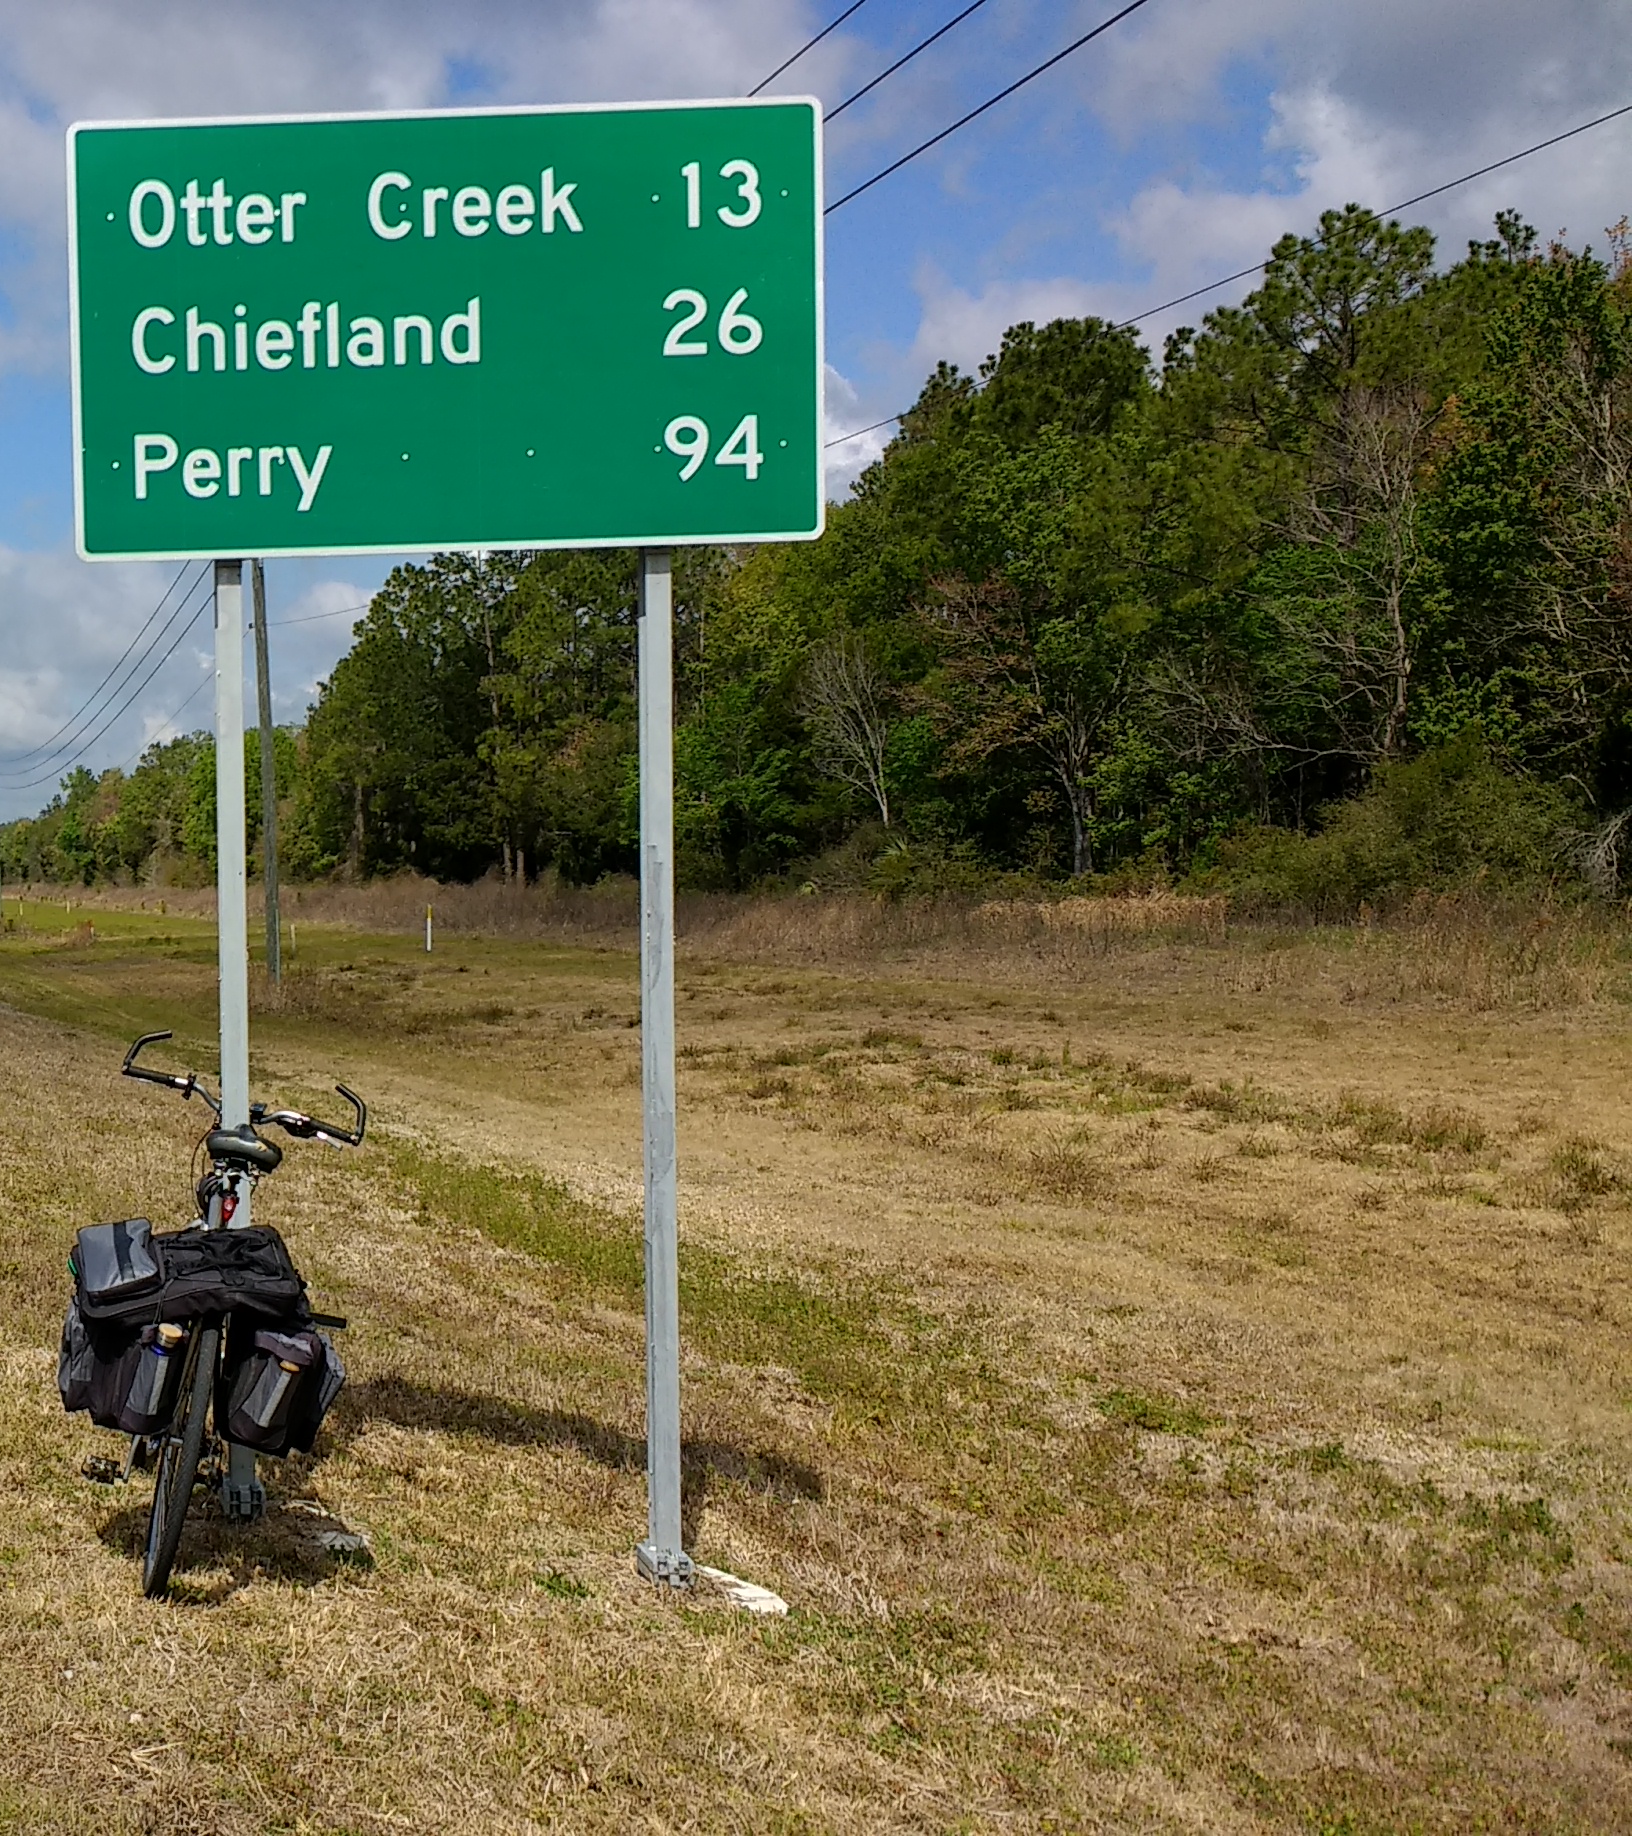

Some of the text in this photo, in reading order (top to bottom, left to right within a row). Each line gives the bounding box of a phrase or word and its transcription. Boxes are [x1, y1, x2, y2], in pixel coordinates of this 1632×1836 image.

[128, 158, 763, 248] Otter Creek 13
[131, 287, 764, 374] Chiefland 26
[133, 414, 765, 512] Perry 94
